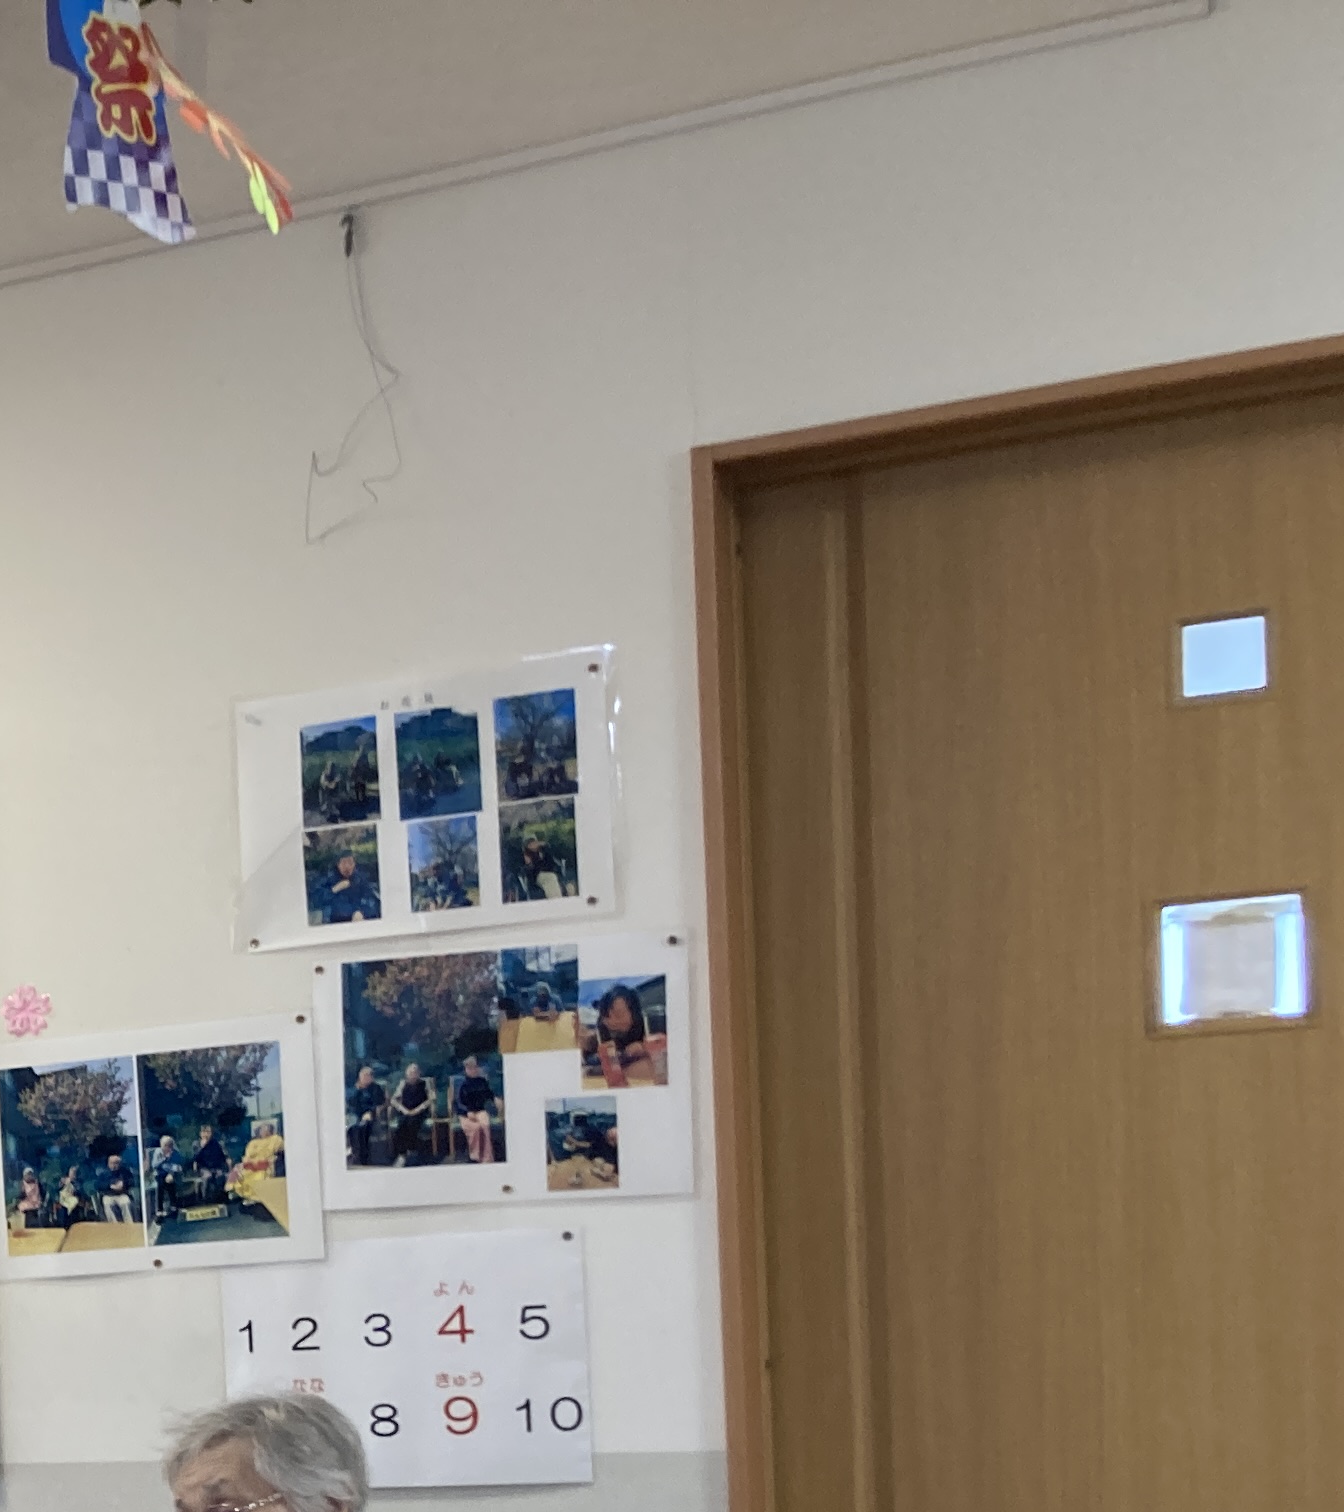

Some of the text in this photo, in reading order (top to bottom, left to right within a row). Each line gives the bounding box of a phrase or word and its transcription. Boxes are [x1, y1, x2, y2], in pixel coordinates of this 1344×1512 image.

[83, 13, 155, 145] 祭
[433, 1280, 475, 1297] よん
[238, 1304, 551, 1353] 1 2 3 4 5
[434, 1372, 485, 1388] きゅう
[370, 1396, 584, 1438] 8 9 10
